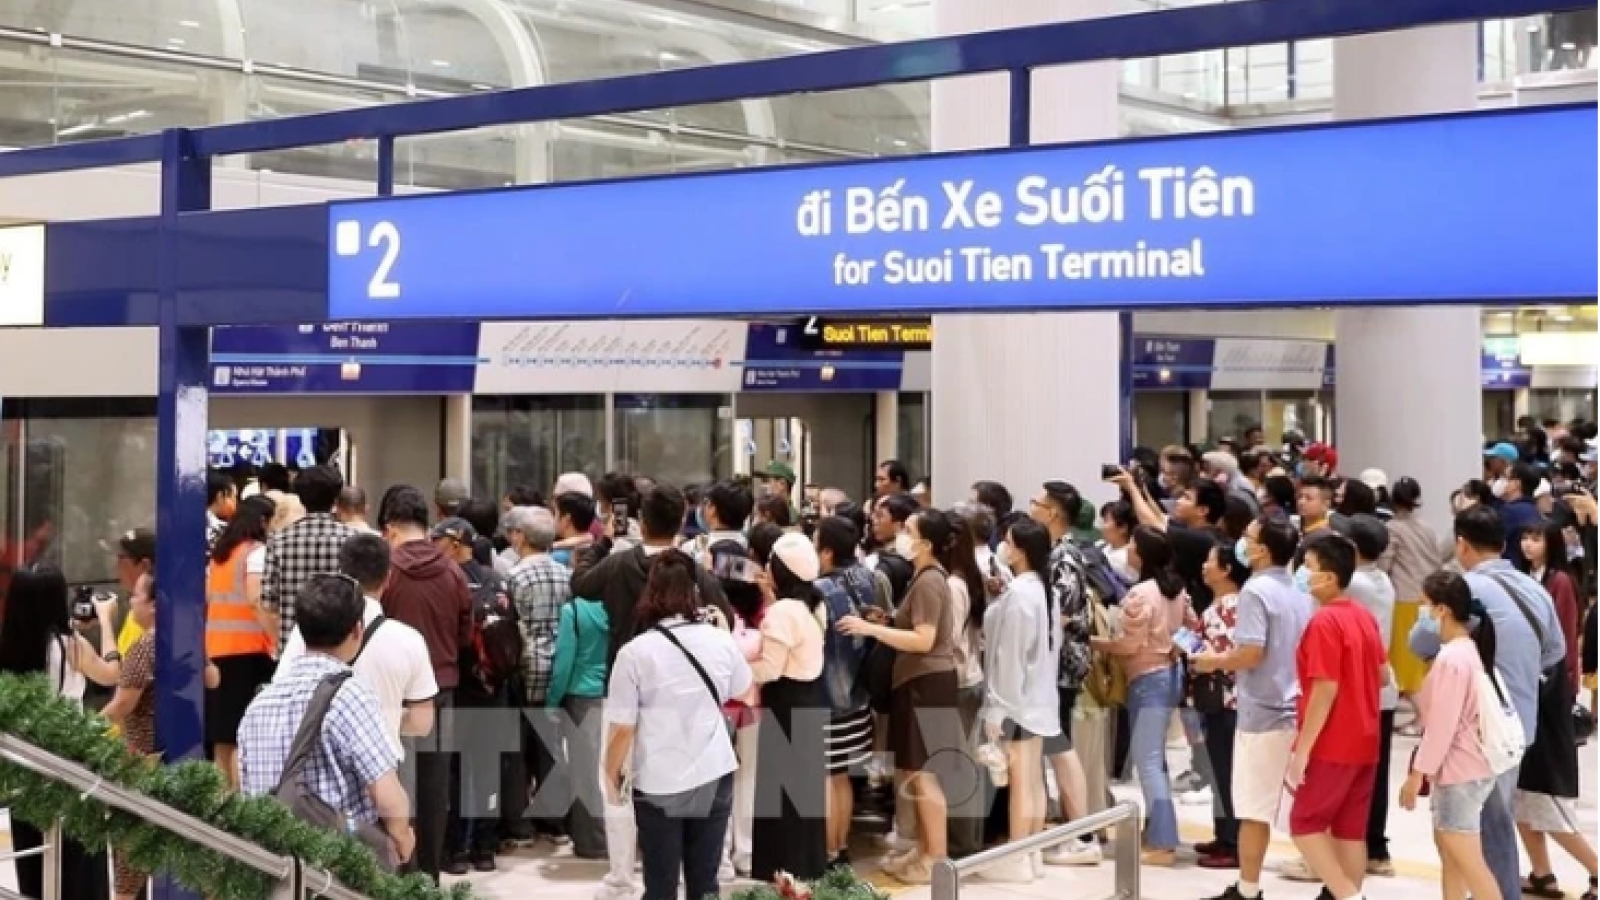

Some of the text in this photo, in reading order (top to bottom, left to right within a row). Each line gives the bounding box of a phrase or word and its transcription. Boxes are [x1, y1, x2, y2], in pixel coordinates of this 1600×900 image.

[797, 164, 1254, 236] đi Bến Xe Suối Tiên
[368, 221, 401, 298] 2
[834, 238, 1205, 285] for Suoi Tien Terminal
